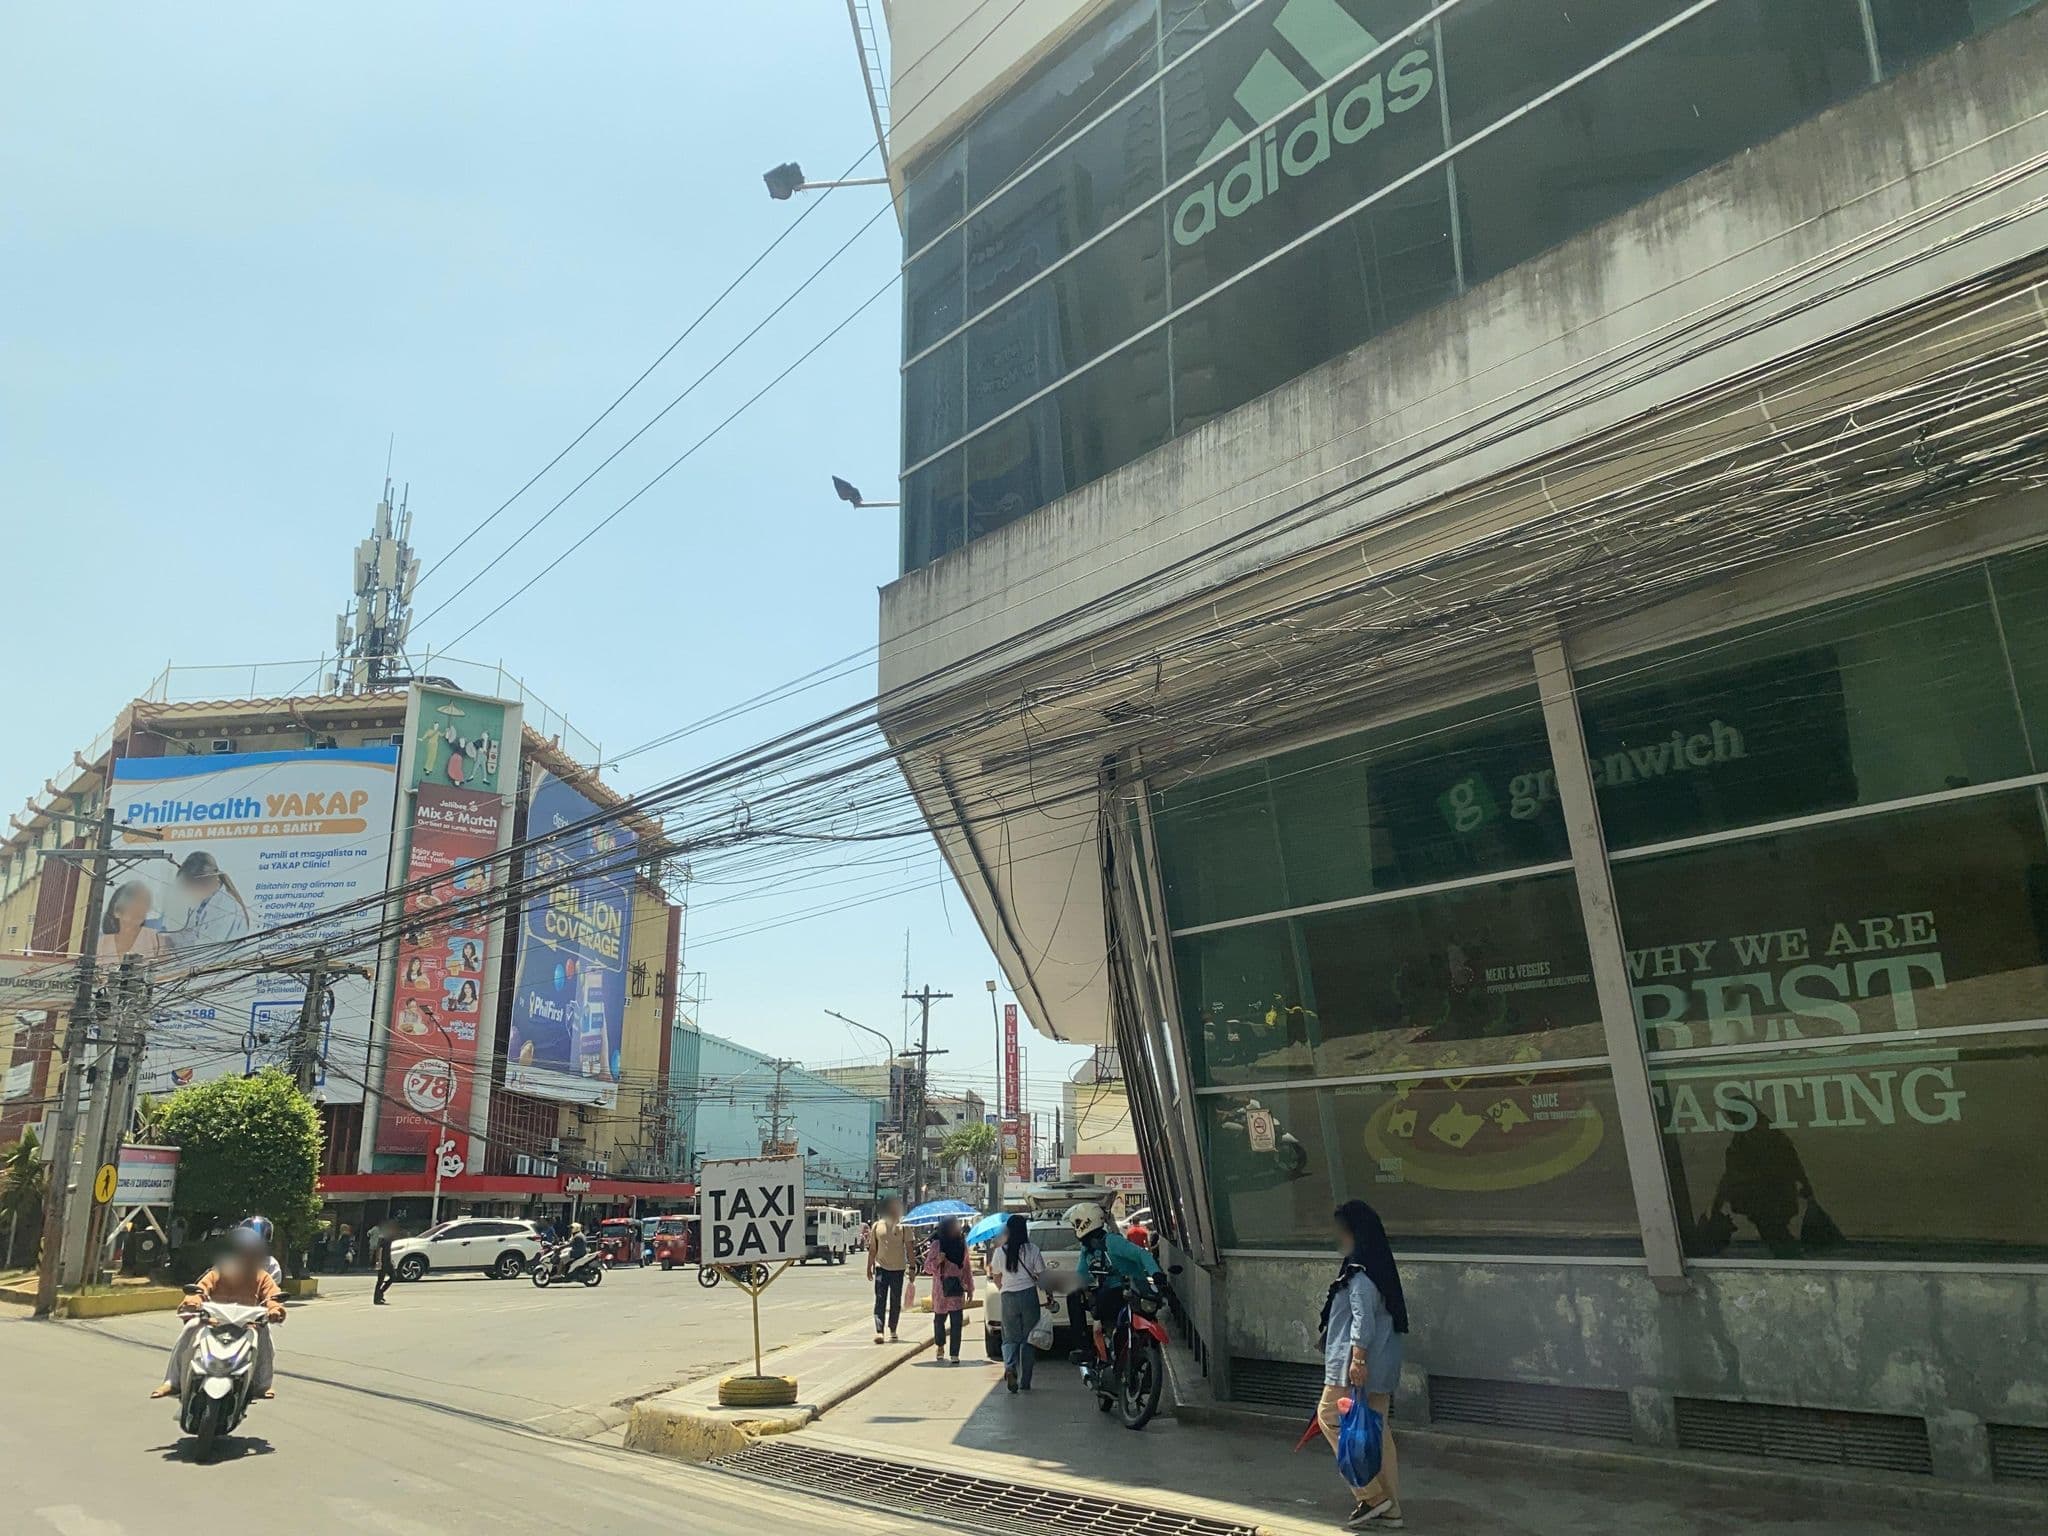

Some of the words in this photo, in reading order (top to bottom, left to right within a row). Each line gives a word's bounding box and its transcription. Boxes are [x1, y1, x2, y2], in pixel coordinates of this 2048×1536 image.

[1173, 49, 1433, 246] adidas
[1509, 719, 1747, 820] grnwich
[127, 797, 261, 824] PhilHealth
[266, 790, 369, 818] YAKAP
[439, 800, 468, 811] Jollibee
[417, 806, 441, 820] Mix
[444, 810, 455, 822] &
[457, 813, 497, 828] Match
[171, 828, 202, 839] PARA
[262, 824, 279, 834] SA
[283, 822, 322, 834] SAKIT
[259, 850, 289, 859] Pumili
[301, 849, 353, 860] magpalista
[355, 849, 367, 857] na
[412, 846, 431, 857] Enjoy
[258, 862, 269, 870] sa
[271, 861, 301, 869] YAKAP
[302, 860, 331, 869] Clinic!
[410, 860, 432, 869] Mains
[411, 854, 455, 866] Best-Tasting
[309, 880, 344, 889] alinman
[298, 902, 315, 910] App
[545, 910, 621, 961] COVERAGE
[1730, 927, 1810, 966] WE
[1824, 910, 1938, 956] ARE
[1485, 966, 1507, 981] MEAT
[1508, 965, 1516, 979] &
[1516, 961, 1551, 977] VEGGIES
[1531, 1093, 1559, 1108] SAUCE
[395, 1114, 421, 1126] price
[708, 1185, 796, 1221] TAXI
[712, 1219, 794, 1258] BAY
